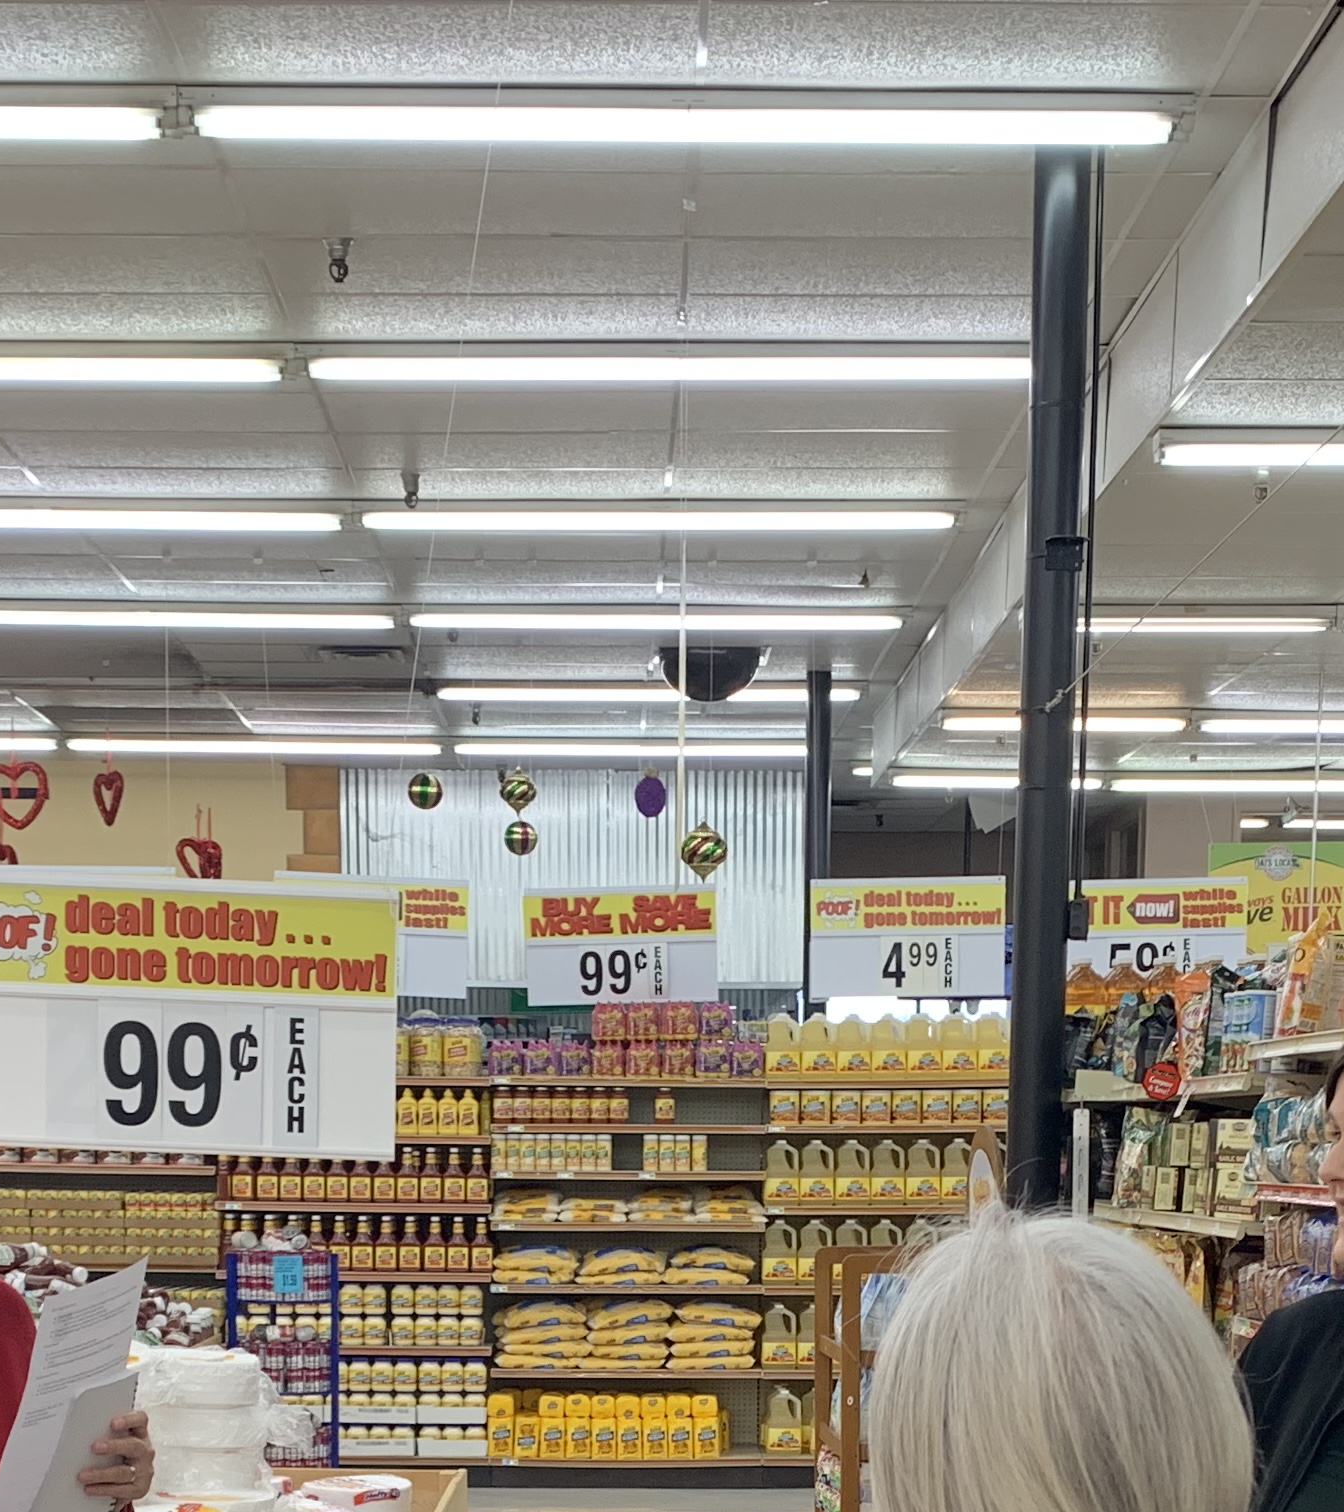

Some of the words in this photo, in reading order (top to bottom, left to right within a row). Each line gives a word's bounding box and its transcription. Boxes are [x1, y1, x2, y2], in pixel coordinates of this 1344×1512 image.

[405, 888, 460, 903] while
[863, 889, 903, 908] deal
[1182, 888, 1238, 901] while
[1281, 886, 1343, 905] GALLON
[64, 894, 154, 938] deal
[404, 902, 467, 917] supplies
[541, 896, 600, 918] BUY
[632, 894, 699, 913] SAVE
[816, 899, 862, 918] POOF!
[1102, 895, 1124, 925] IT
[1135, 899, 1175, 918] now!
[1182, 901, 1245, 915] supplies
[1247, 904, 1273, 926] ve
[405, 915, 449, 929] last!
[529, 914, 614, 937] MORE
[619, 907, 713, 935] MORE
[863, 910, 908, 929] gone
[910, 908, 1002, 927] tomorrow!
[1182, 915, 1227, 929] last!
[64, 944, 167, 984] gone
[175, 947, 387, 993] tomorrow!
[579, 948, 649, 997] 99¢
[653, 945, 663, 996] EACH
[944, 937, 953, 989] EACH
[103, 1020, 259, 1128] 99¢
[286, 1017, 307, 1134] EACH
